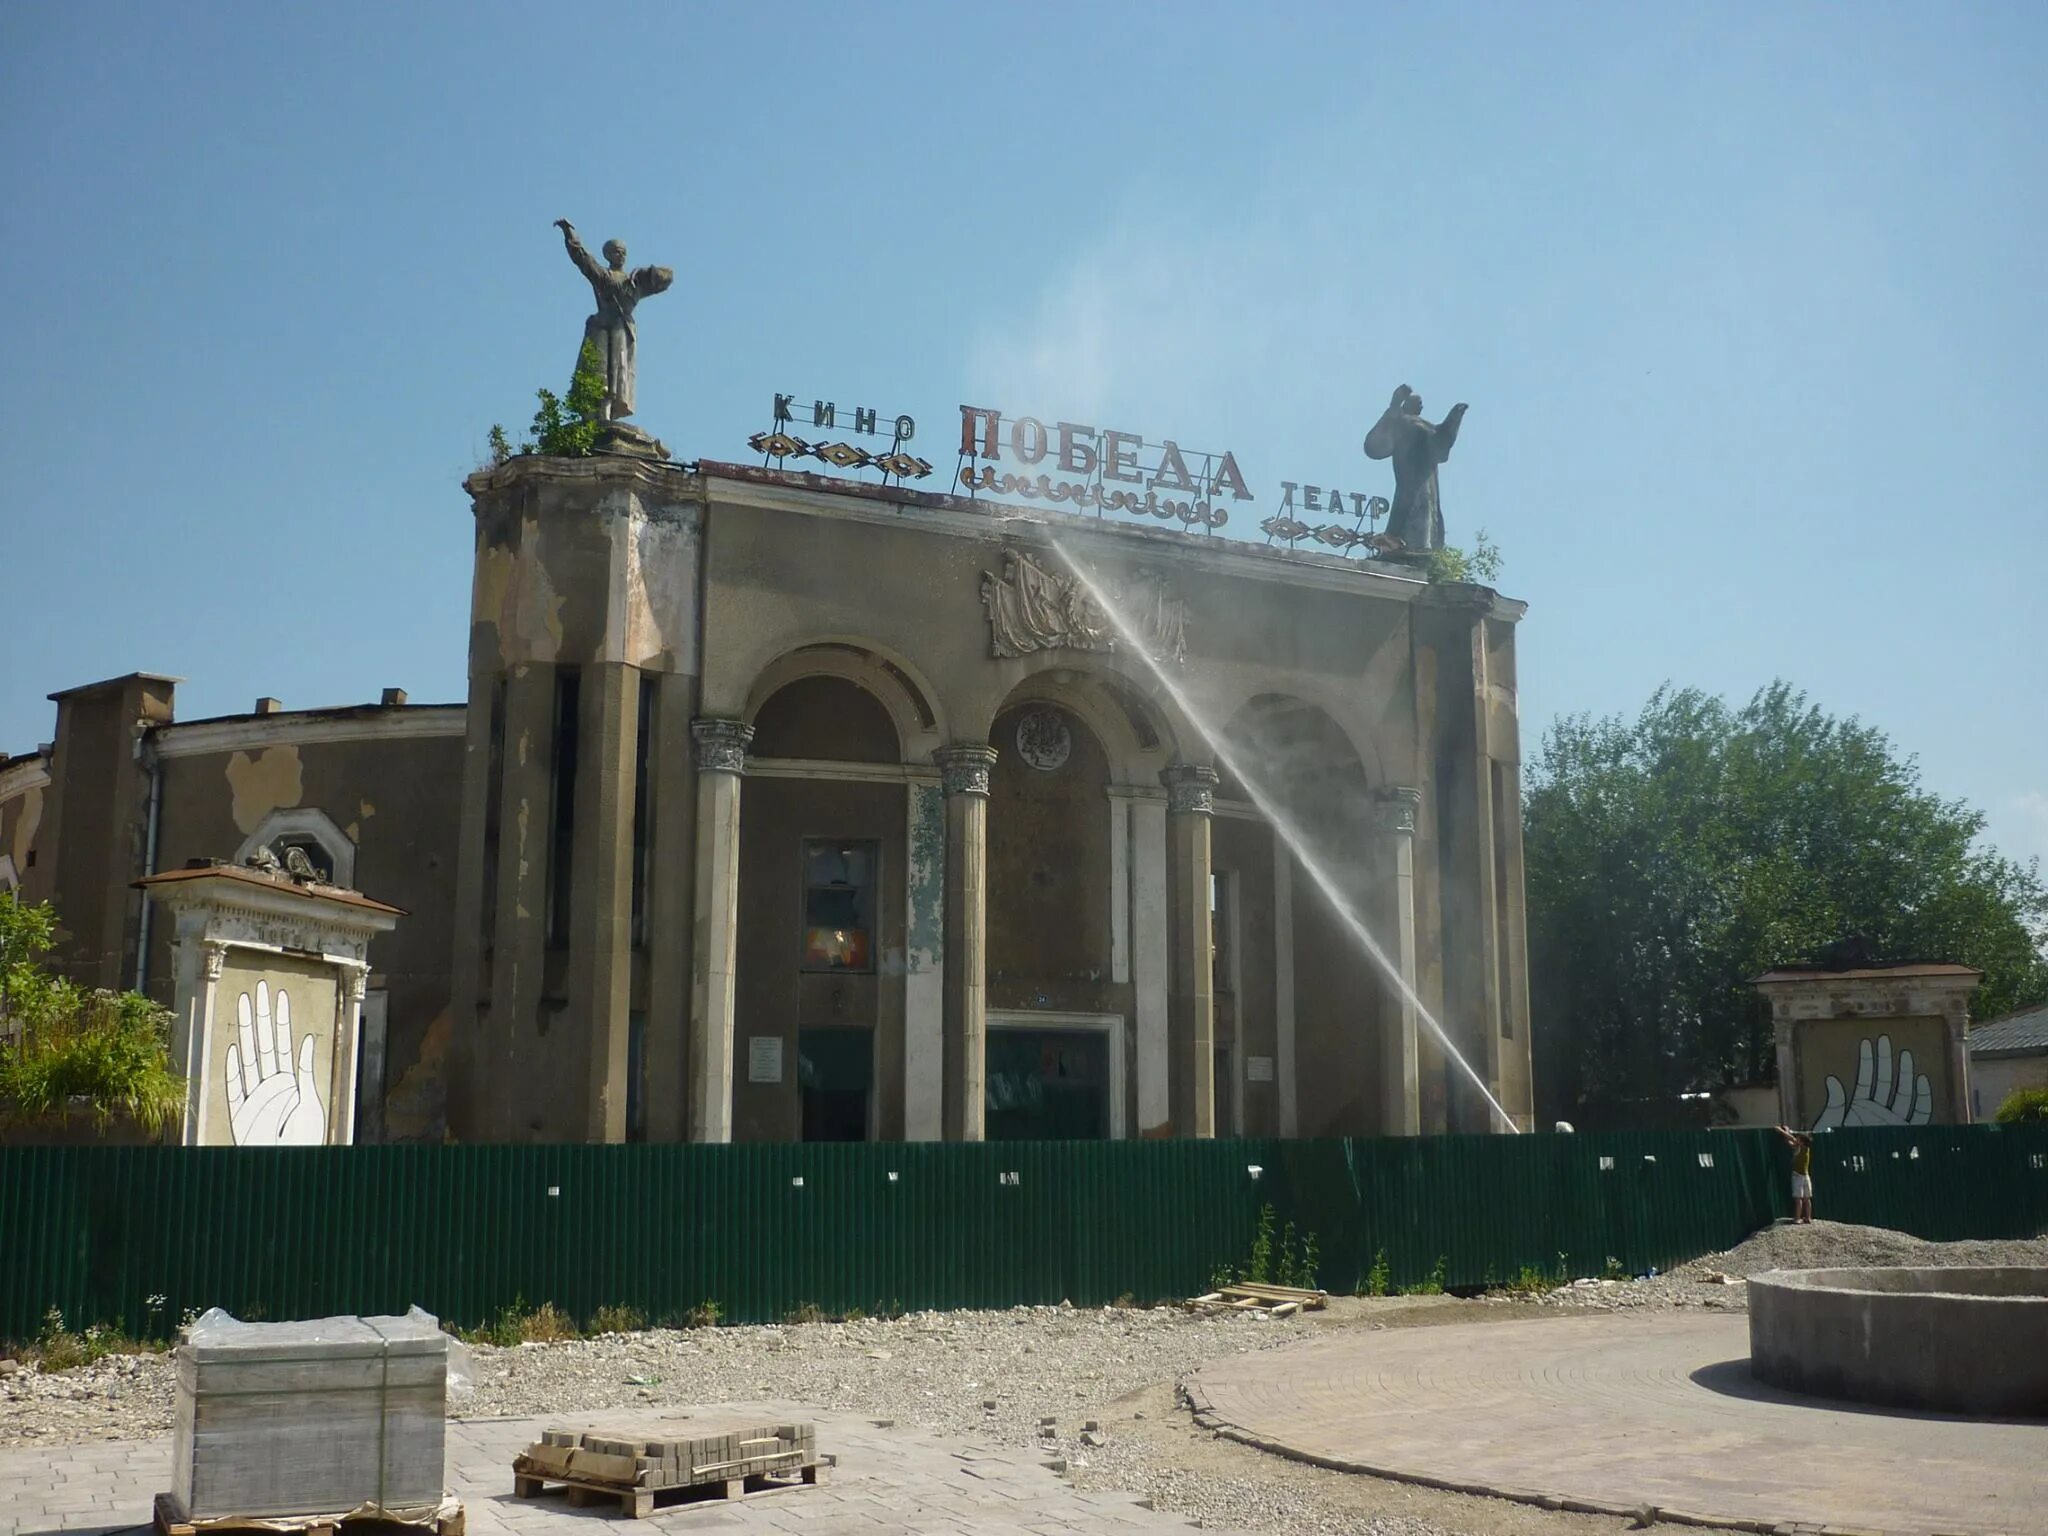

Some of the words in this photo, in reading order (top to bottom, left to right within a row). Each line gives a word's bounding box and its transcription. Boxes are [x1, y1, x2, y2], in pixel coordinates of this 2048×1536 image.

[774, 393, 915, 441] КИНО
[958, 405, 1254, 500] ПОБЕДА
[1281, 481, 1390, 520] ТЕАТР
